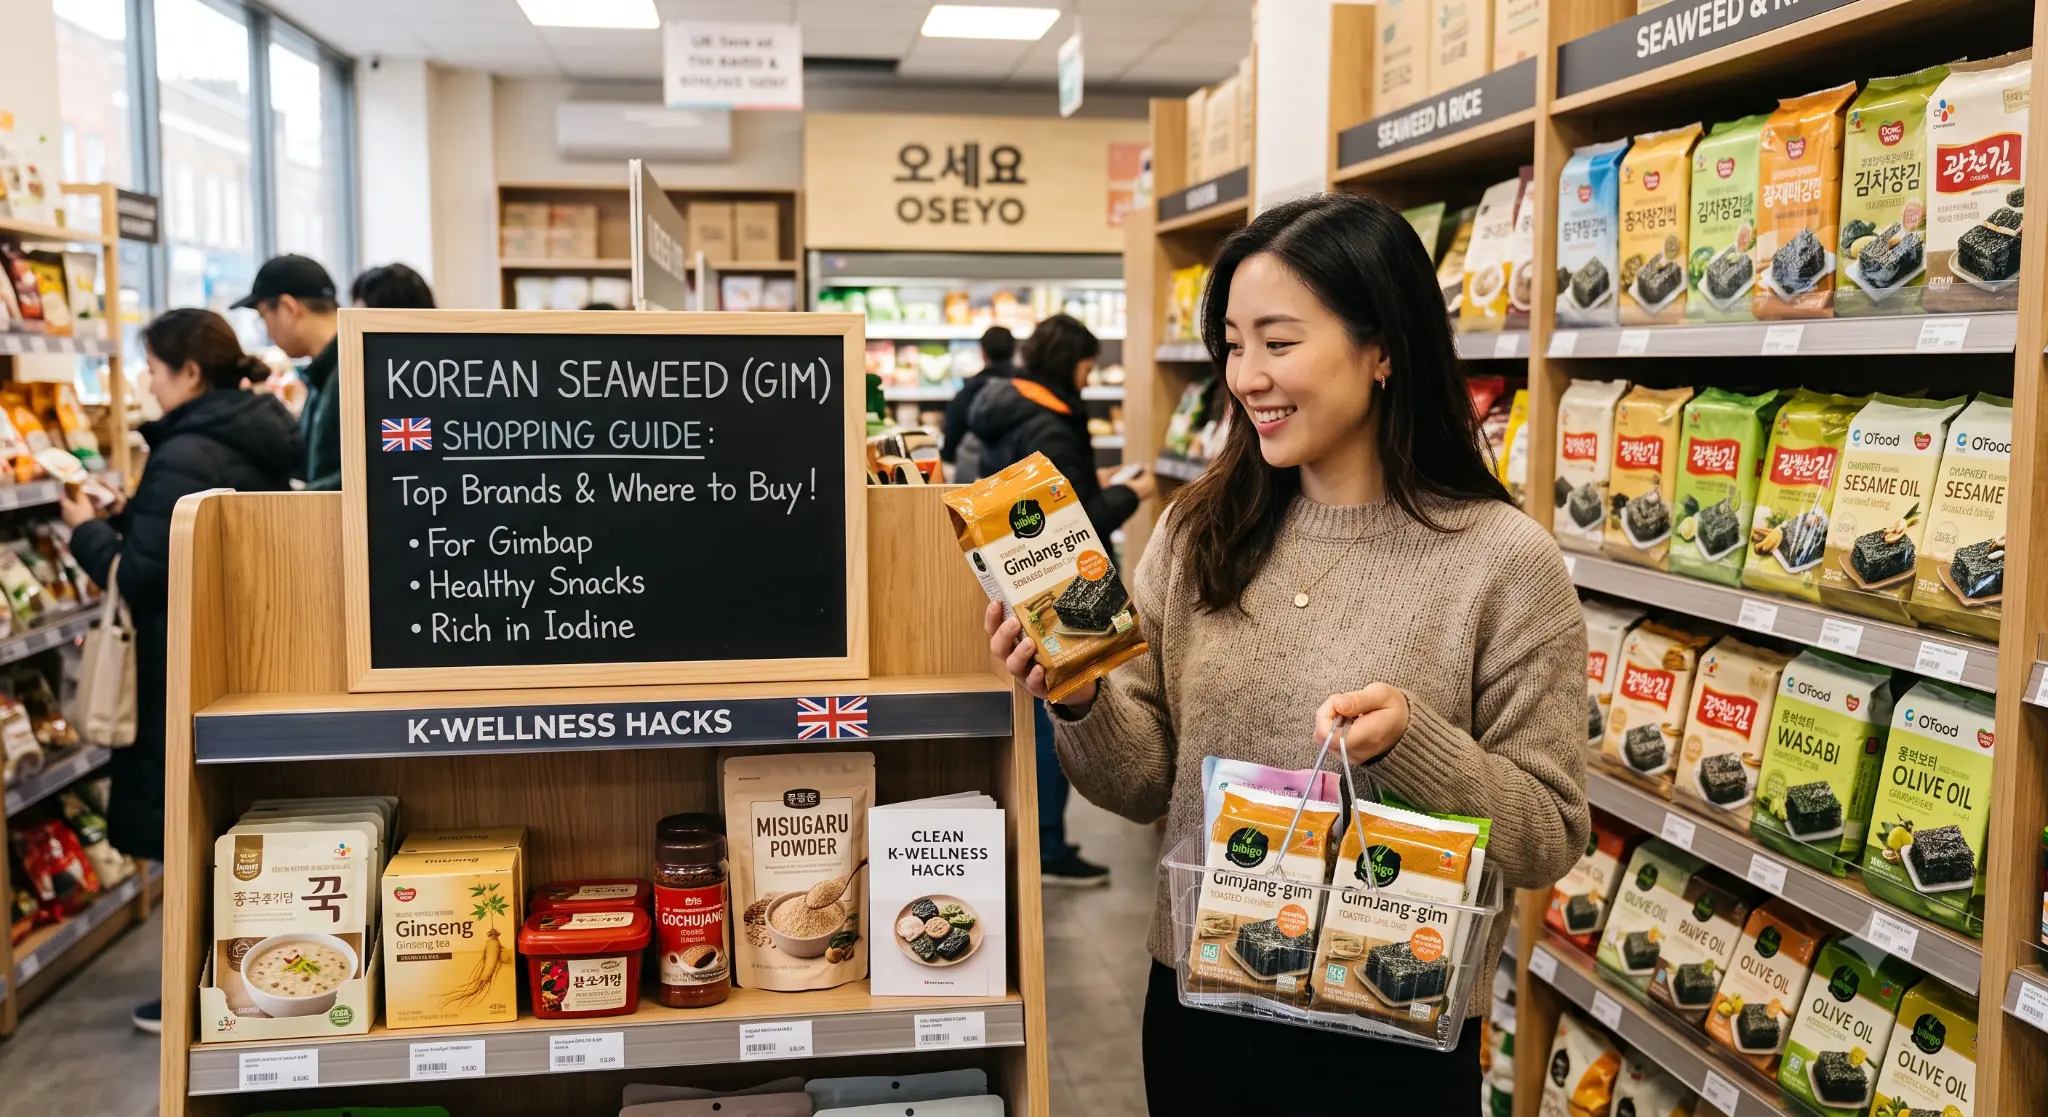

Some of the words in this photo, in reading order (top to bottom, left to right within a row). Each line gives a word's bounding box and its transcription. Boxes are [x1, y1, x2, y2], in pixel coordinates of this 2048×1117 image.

[1636, 0, 1744, 58] SEAWEED
[1377, 107, 1435, 149] SEAWEED
[1436, 102, 1447, 129] &
[1448, 88, 1483, 121] RICE
[893, 141, 1029, 188] 오세요
[896, 196, 1026, 226] OSEYO
[388, 358, 538, 400] KOREAN
[558, 359, 729, 399] SEAWEED
[742, 356, 832, 405] (GIM)
[443, 420, 596, 451] SHOPPING
[393, 476, 447, 515] Top
[462, 473, 562, 505] Brands
[575, 474, 596, 504] &
[608, 473, 696, 503] Where
[708, 473, 737, 502] to
[1843, 474, 1897, 495] SESAME
[1899, 479, 1921, 498] OIL
[1945, 480, 2006, 504] SESAME
[428, 527, 475, 558] For
[489, 526, 593, 564] Gimbap
[430, 569, 535, 609] Healthy
[549, 566, 646, 595] Snacks
[432, 612, 491, 644] Rich
[506, 617, 530, 642] in
[545, 609, 636, 641] Iodine
[407, 708, 617, 745] K-WELLNESS
[626, 706, 734, 737] HACKS
[1919, 715, 1959, 738] O'Food
[1778, 726, 1841, 765] WASABI
[1892, 765, 1946, 800] OLIVE
[1946, 782, 1972, 811] OIL
[757, 813, 849, 838] MISUGARU
[911, 830, 964, 843] CLEAN
[771, 838, 837, 858] POWDER
[888, 847, 989, 861] K-WELLNESS
[1232, 843, 1263, 858] bibigo
[911, 864, 965, 877] HACKS
[1361, 859, 1394, 877] bbigo
[1210, 889, 1242, 903] TOASTED
[396, 920, 474, 939] Ginseng
[662, 910, 723, 928] GOCHUJANG
[1338, 909, 1371, 923] TOASTED
[396, 940, 434, 950] Ginseng
[436, 939, 450, 948] tea
[1709, 936, 1726, 956] OIL
[1740, 955, 1774, 985] OLIVE
[1774, 973, 1790, 996] OIL
[1812, 997, 1853, 1031] OLIVE
[1853, 1020, 1873, 1044] OIL
[1897, 1050, 1945, 1087] OLIVE
[1945, 1076, 1968, 1103] OIL
